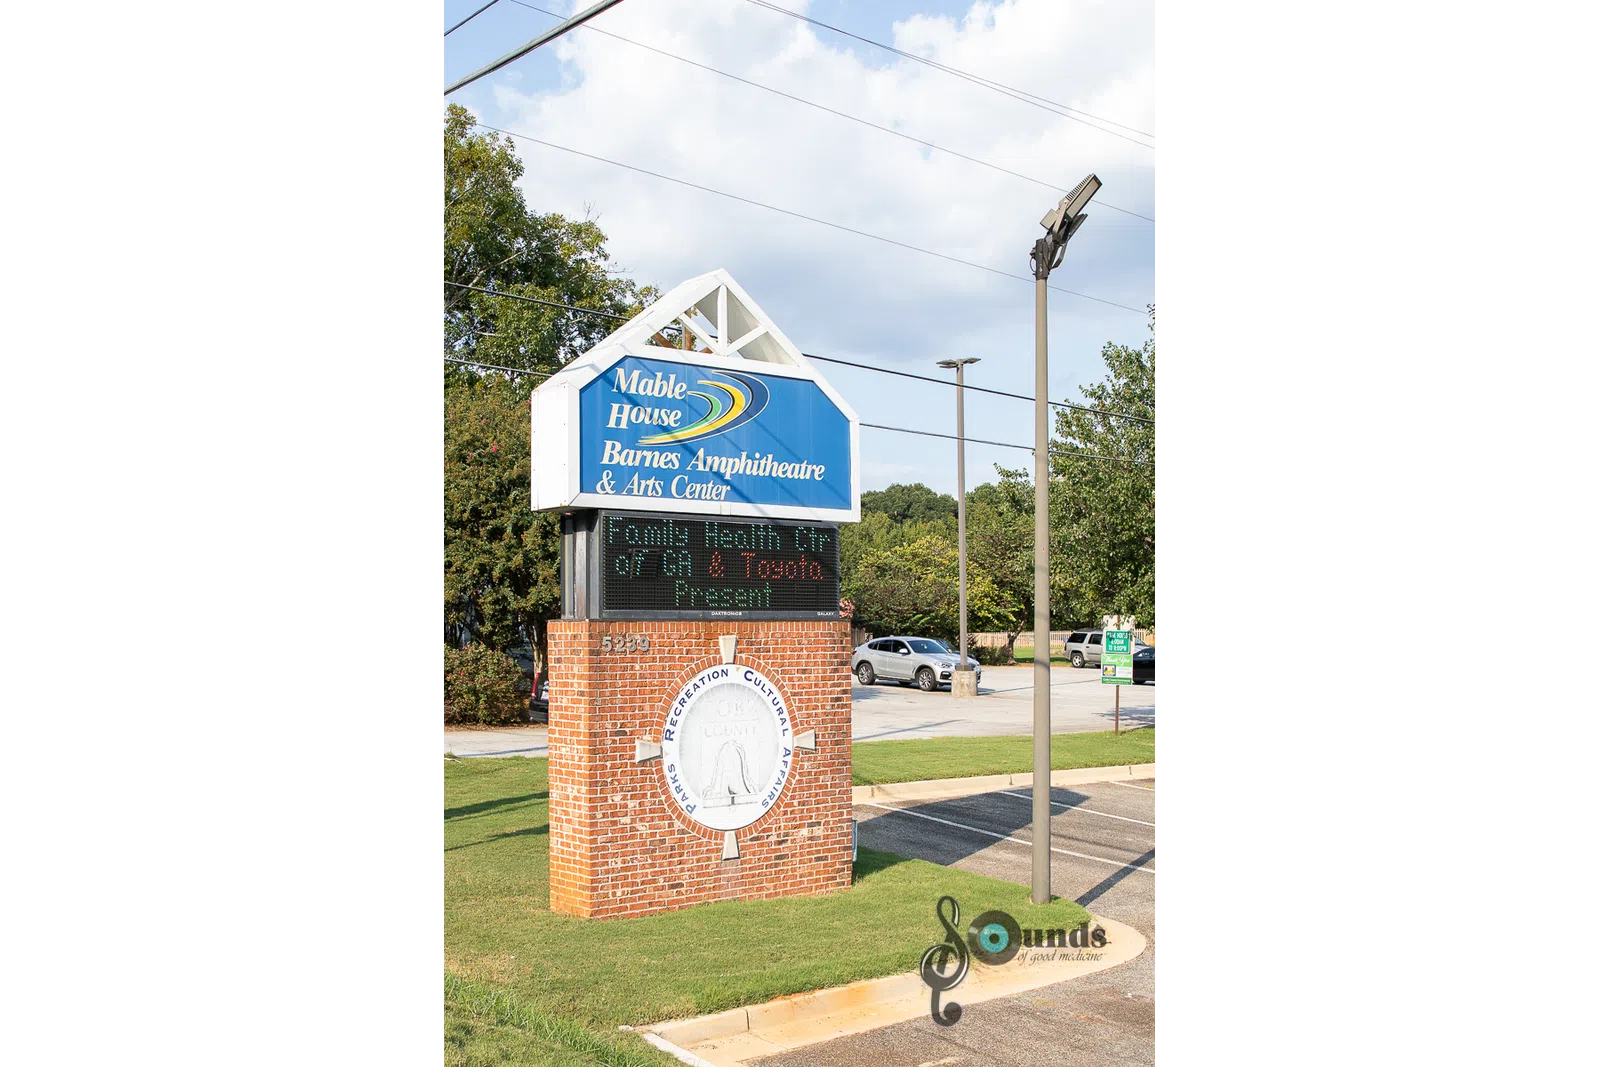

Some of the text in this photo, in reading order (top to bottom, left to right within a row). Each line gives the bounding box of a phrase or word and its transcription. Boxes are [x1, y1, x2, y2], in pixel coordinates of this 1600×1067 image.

[611, 367, 687, 400] Mable
[606, 402, 682, 429] House
[600, 439, 826, 481] Barnes Amphitheatre
[595, 469, 731, 501] & Arts Center
[609, 516, 831, 552] Family Health Ctr
[615, 549, 824, 580] of GA & Toyota
[675, 580, 772, 607] Present
[601, 636, 651, 653] 5239
[664, 668, 791, 814] PARKS RECREATION CULTURAL AFFAIRS
